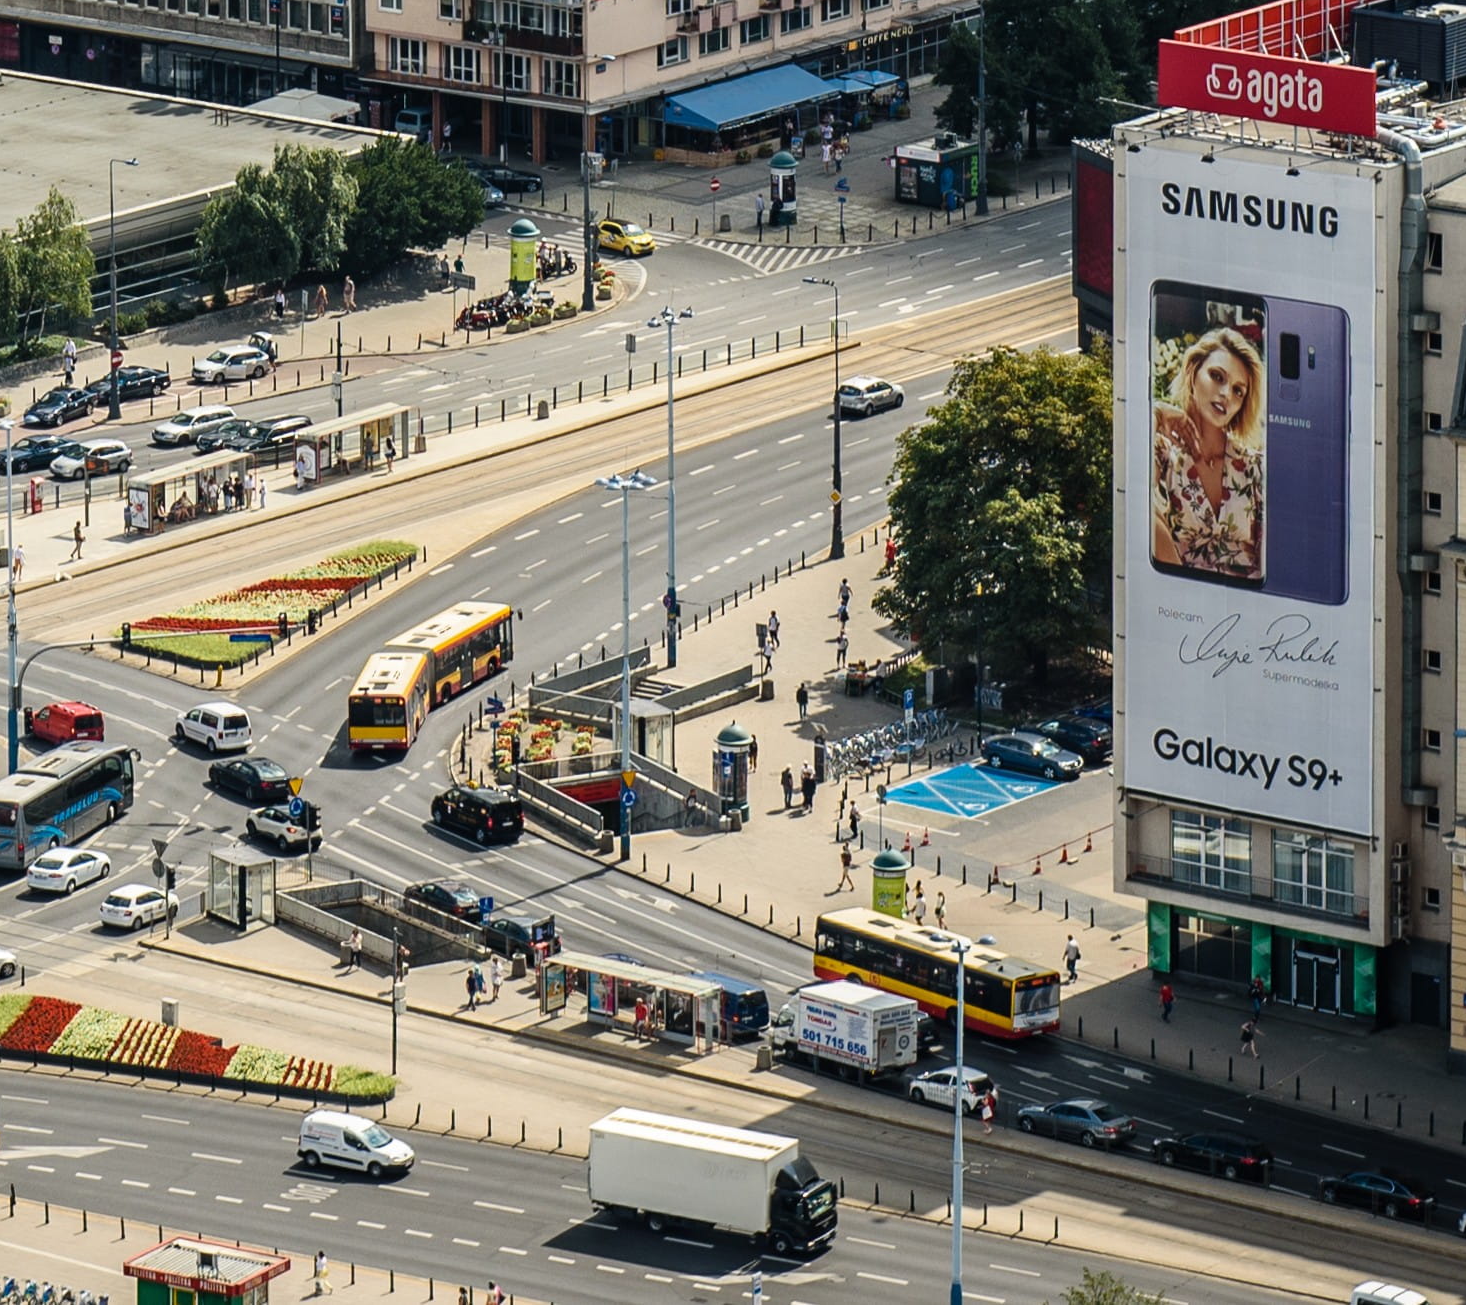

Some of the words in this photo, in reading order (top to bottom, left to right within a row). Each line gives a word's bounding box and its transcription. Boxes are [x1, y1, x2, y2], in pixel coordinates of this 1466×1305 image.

[1246, 68, 1322, 117] agata
[1161, 182, 1339, 238] SAMSUNG
[1268, 413, 1312, 429] SAMSUNG
[1262, 669, 1340, 692] Supermodelka
[1153, 728, 1280, 790] Galaxy
[1287, 754, 1342, 790] S9+
[803, 1028, 822, 1043] 501
[825, 1035, 844, 1050] 715
[847, 1041, 868, 1057] 656
